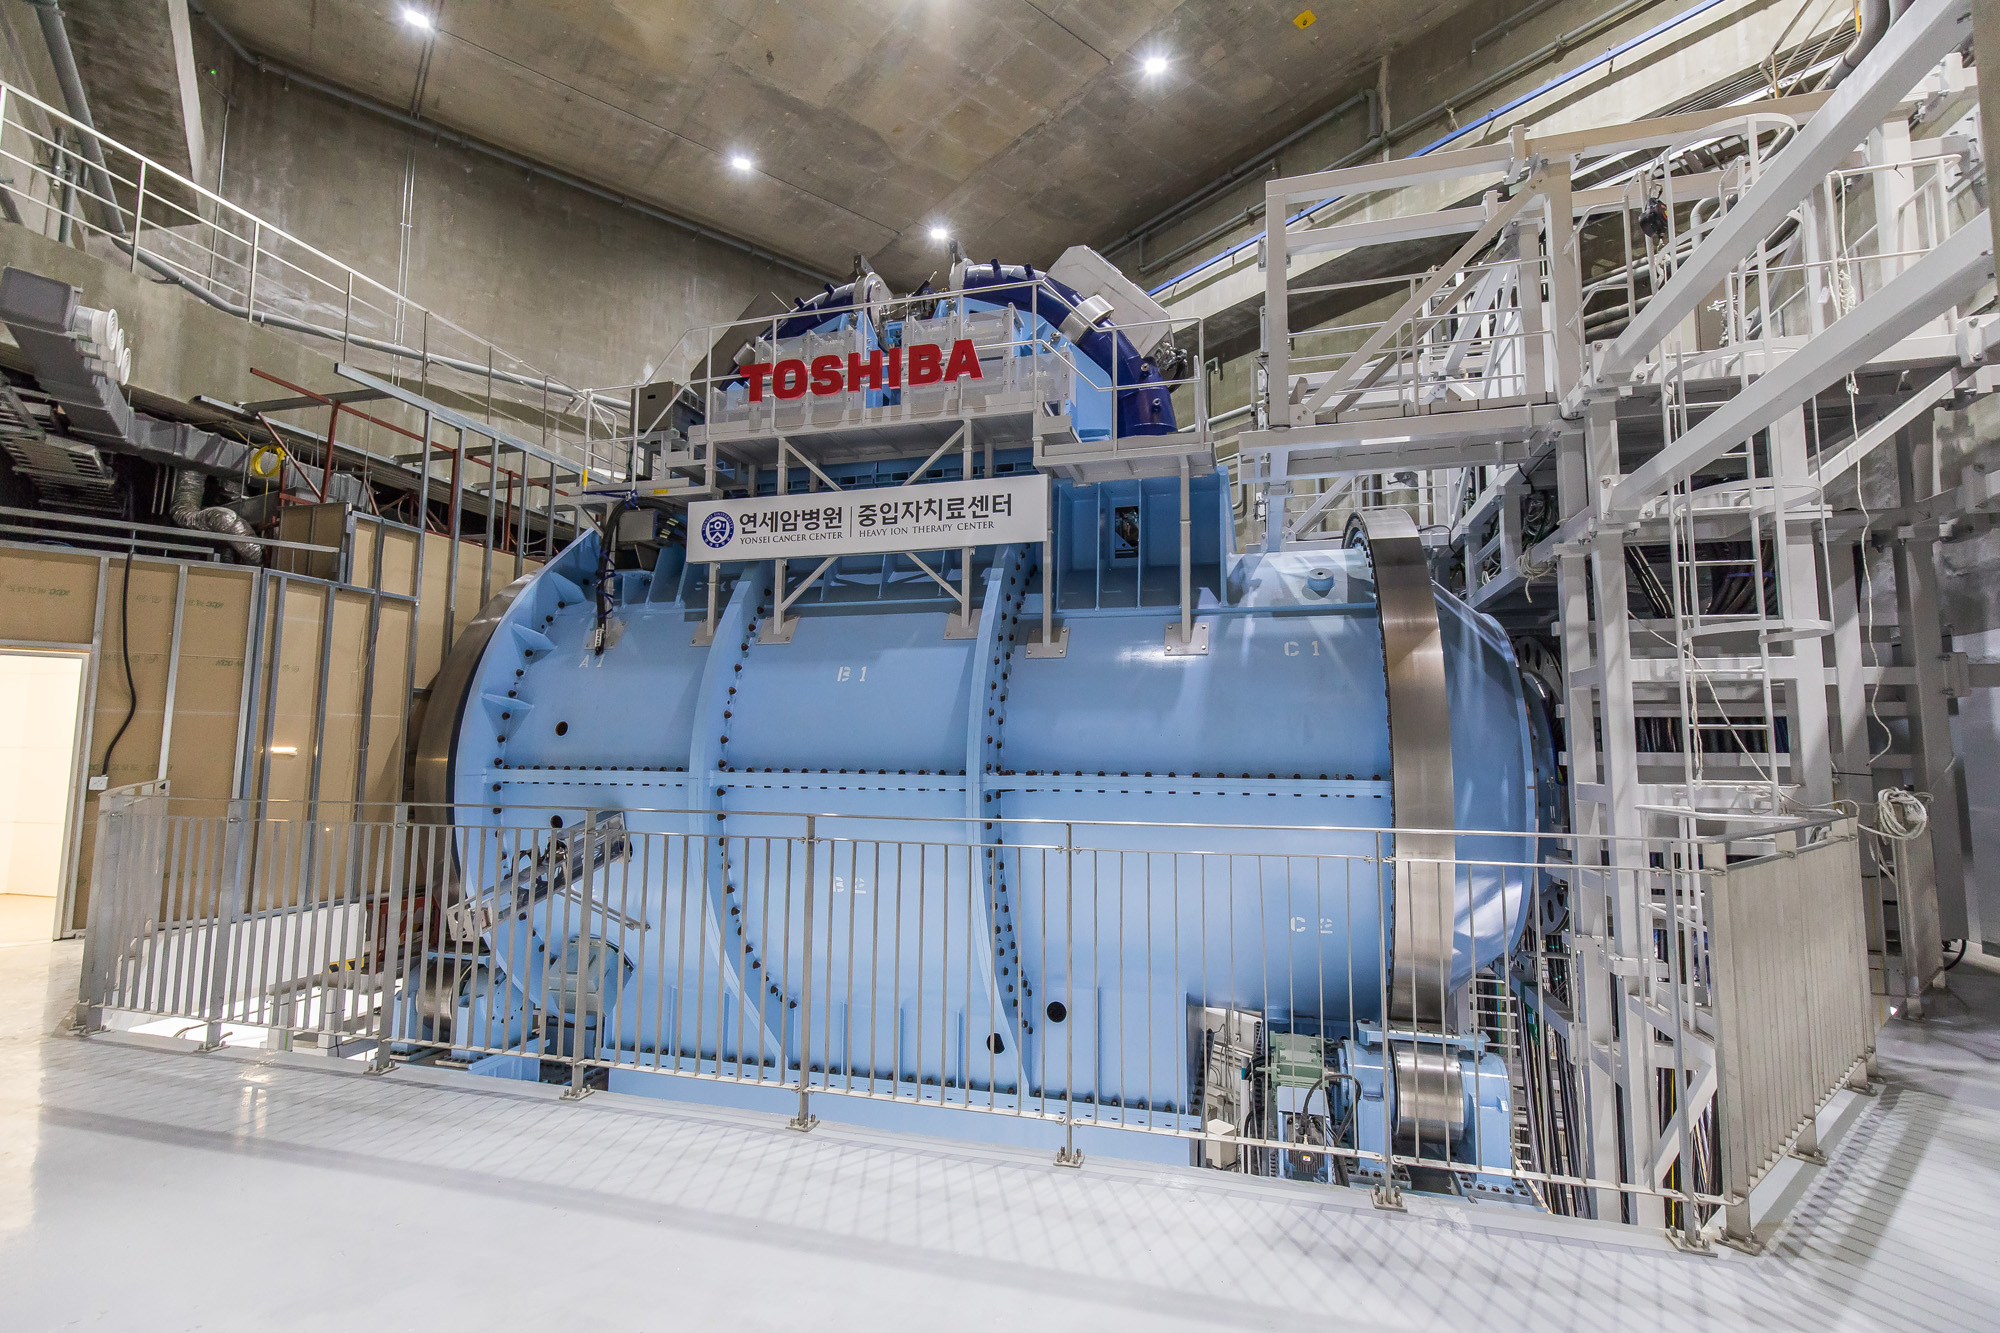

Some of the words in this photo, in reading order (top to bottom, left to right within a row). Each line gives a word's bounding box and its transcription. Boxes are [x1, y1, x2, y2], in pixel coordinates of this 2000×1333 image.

[740, 339, 984, 403] TOSHIBA
[739, 507, 842, 535] 연세암병원
[858, 493, 1012, 527] 중입자치료센터
[740, 536, 770, 545] YONSEI
[772, 534, 807, 543] CANCER
[809, 532, 843, 541] CENTER
[859, 528, 887, 538] HEAVY
[890, 527, 908, 536] ION
[912, 523, 953, 534] THERAPY
[957, 520, 995, 531] CENTER
